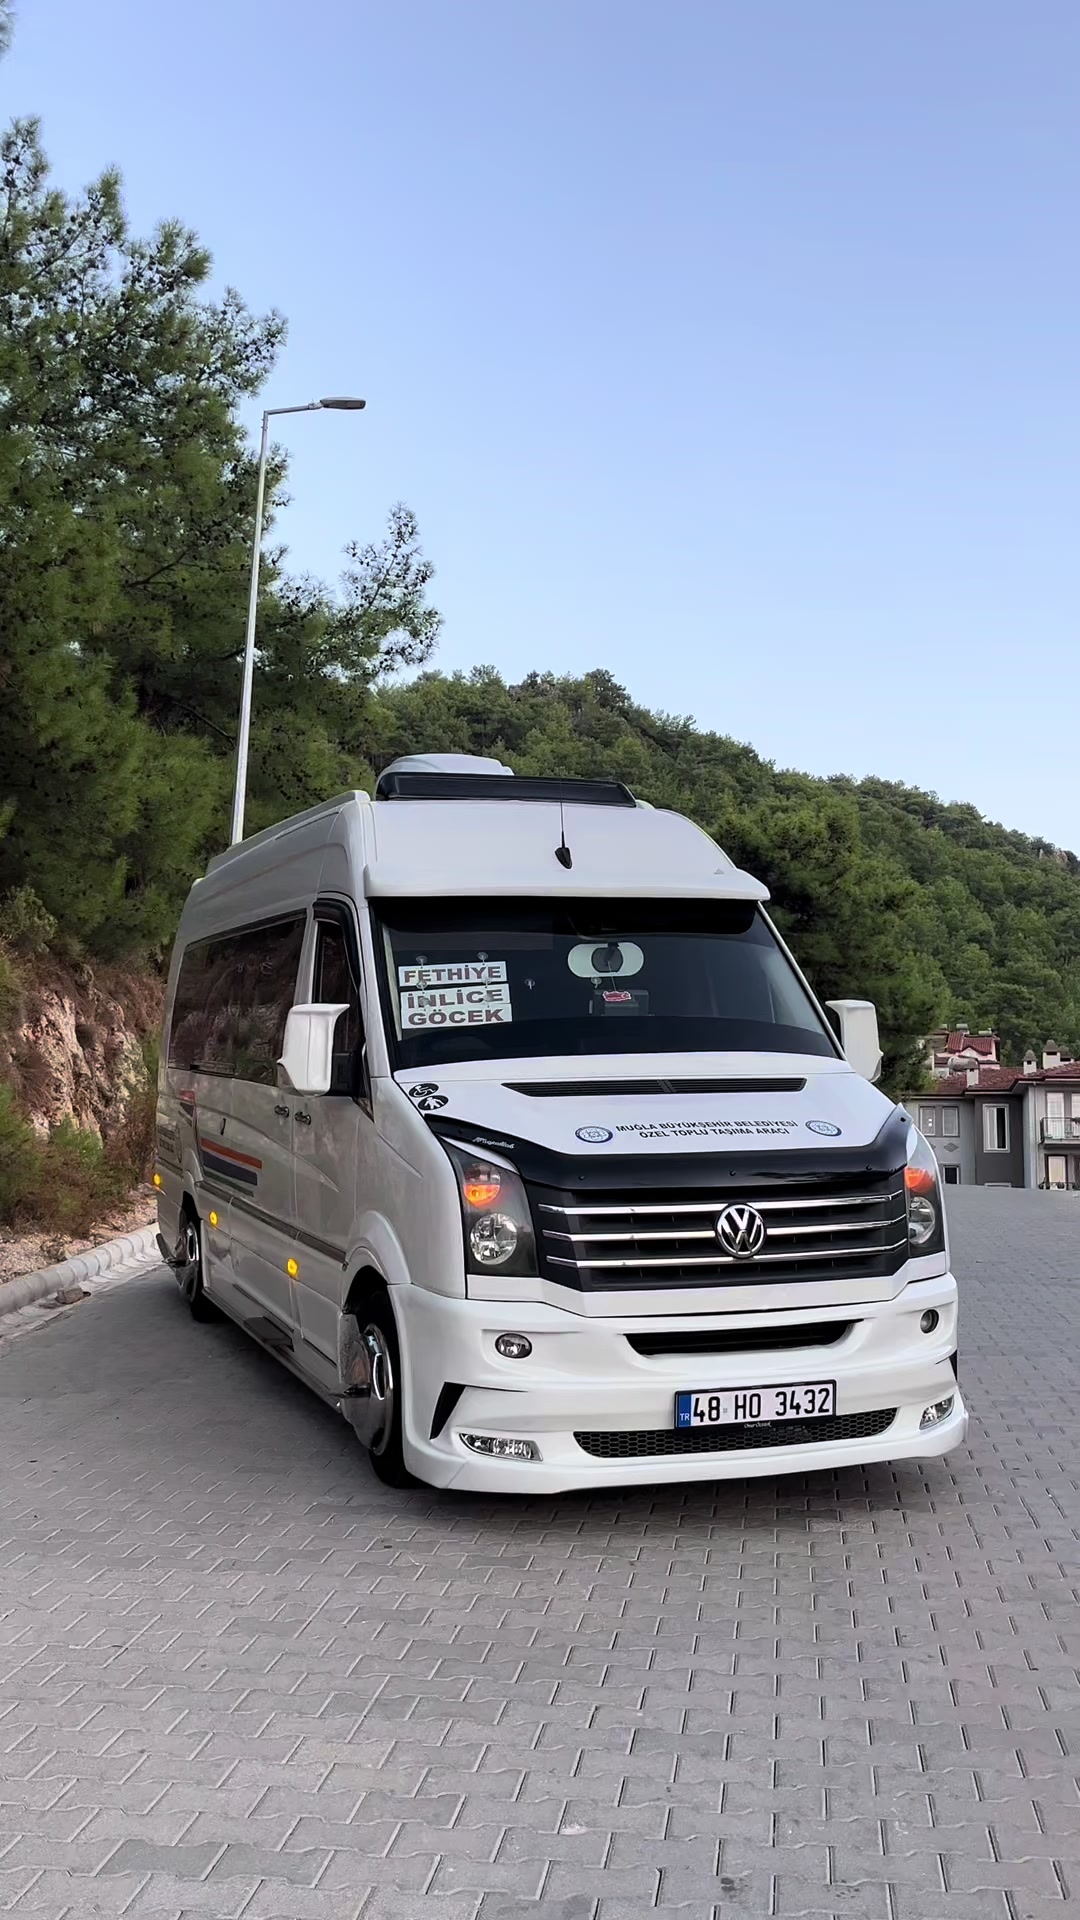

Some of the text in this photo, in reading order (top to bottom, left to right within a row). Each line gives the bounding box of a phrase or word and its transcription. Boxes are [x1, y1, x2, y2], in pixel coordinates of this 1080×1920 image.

[404, 965, 501, 983] FETHİYE
[407, 989, 503, 1009] İNLİCE
[408, 1009, 504, 1026] GÖCEK
[615, 1119, 798, 1132] MUĞLA BÜYÜKŞEHİR BELEDİYESİ
[639, 1127, 790, 1138] ÖZEL TOPLU TAŞIMA ARACI
[679, 1388, 830, 1423] TR 48 HO 3432
